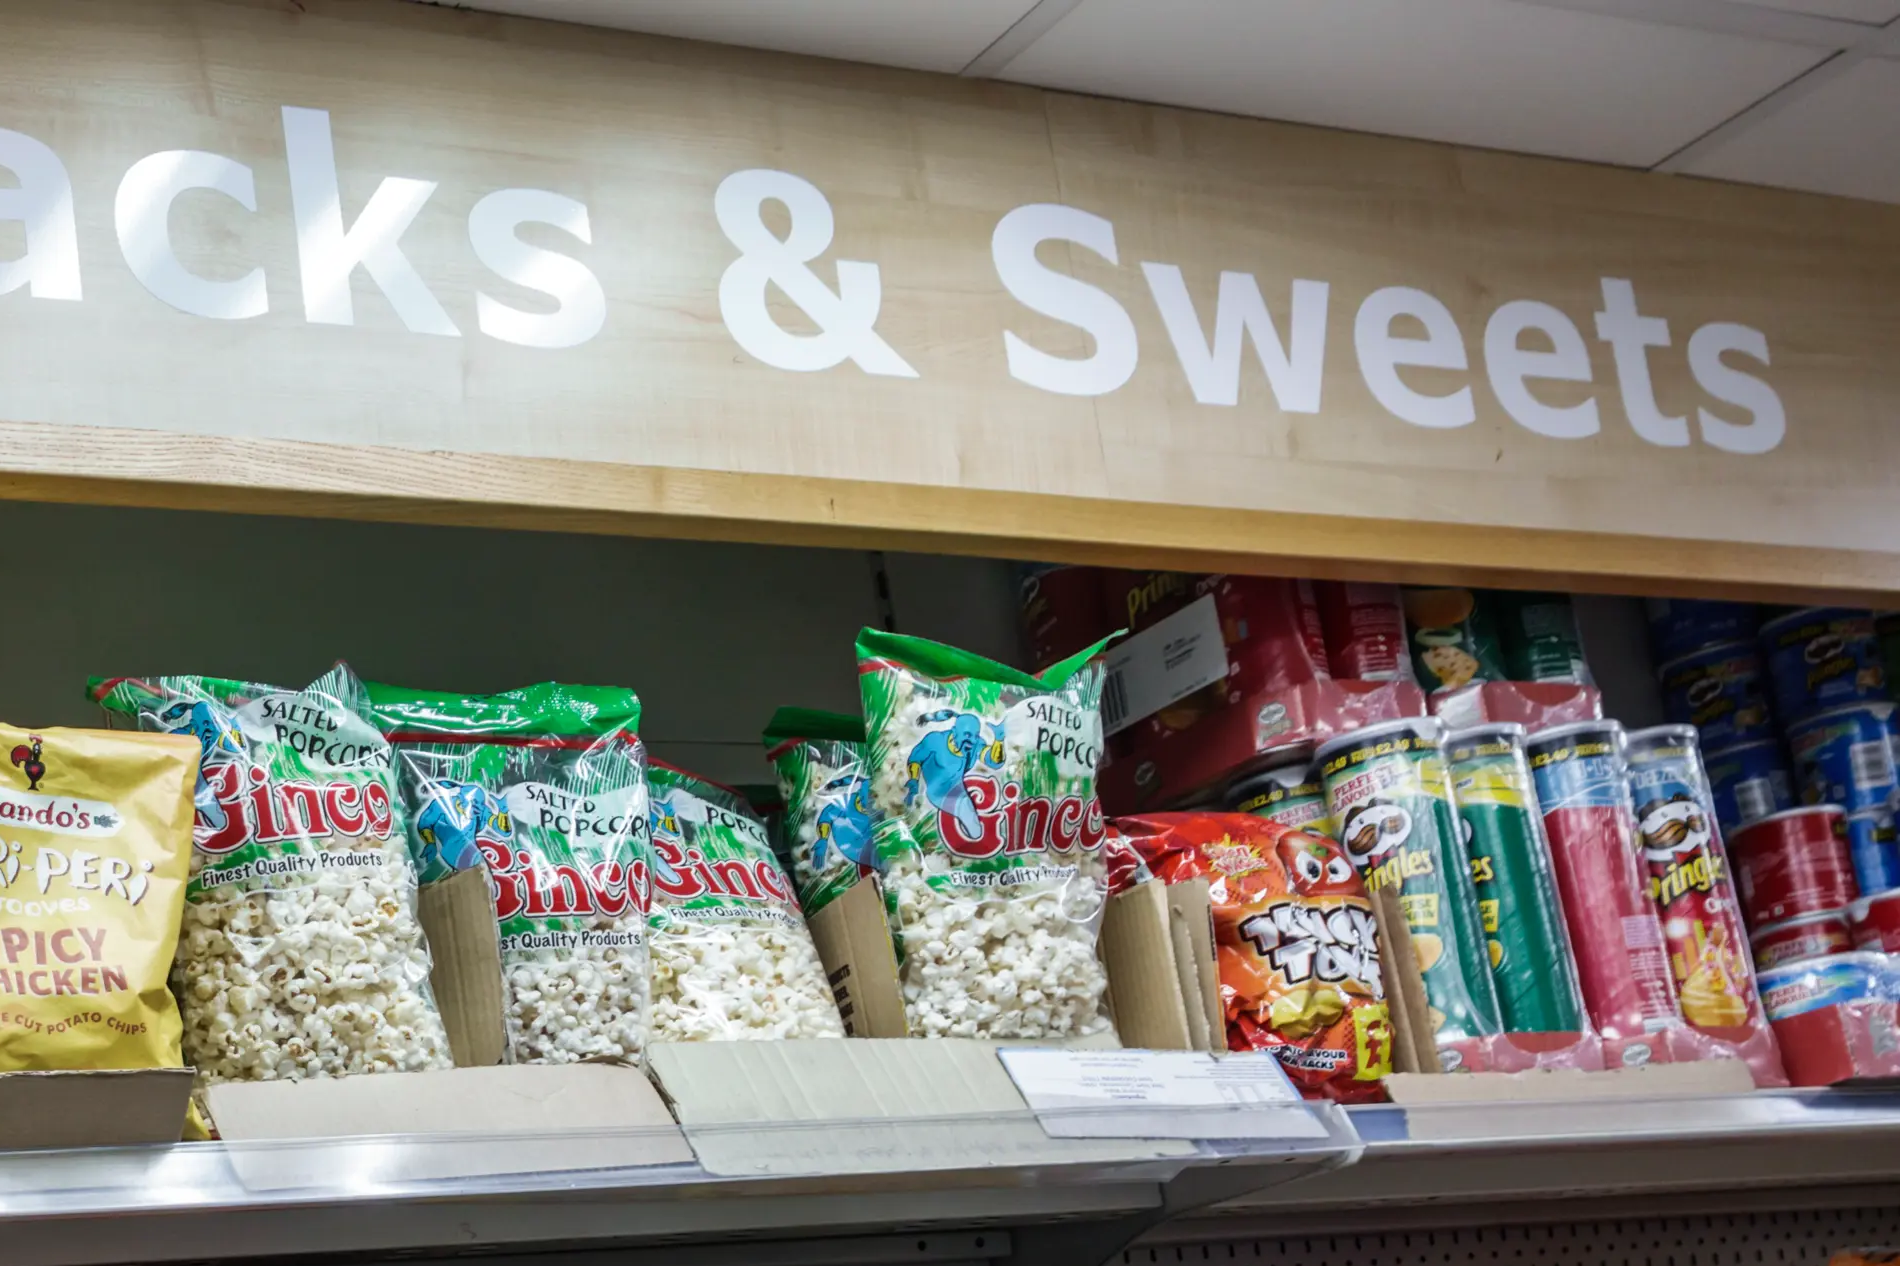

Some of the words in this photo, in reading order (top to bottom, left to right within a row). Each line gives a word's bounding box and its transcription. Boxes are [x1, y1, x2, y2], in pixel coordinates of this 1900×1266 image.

[714, 168, 921, 379] &
[991, 203, 1786, 455] Sweets
[1026, 700, 1082, 731] SALTED
[274, 722, 391, 769] POPCORN
[201, 865, 251, 889] Finest
[255, 854, 316, 878] Quality
[319, 850, 383, 869] Products
[951, 871, 996, 888] Finest
[520, 930, 577, 953] Quality
[581, 930, 642, 949] Products
[14, 1014, 43, 1034] CUT
[46, 1011, 102, 1035] POTATO
[106, 1015, 148, 1035] CHIPS
